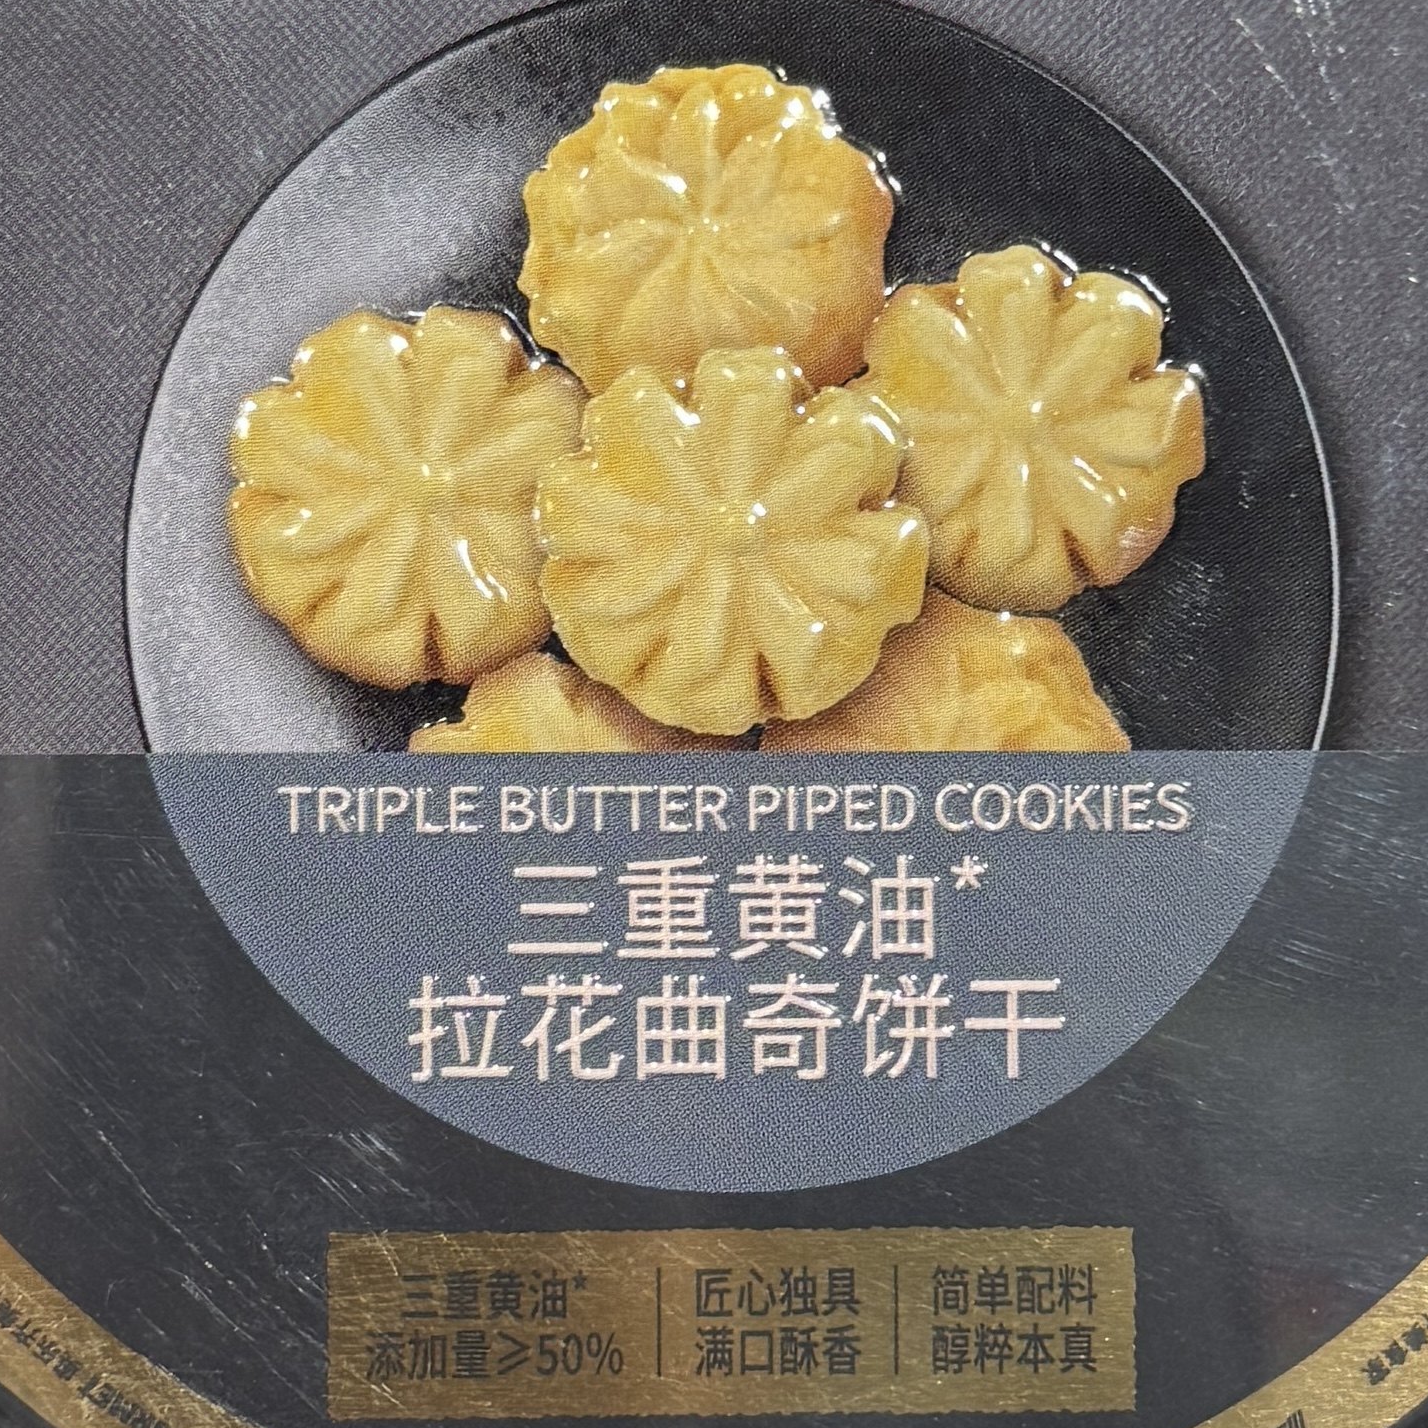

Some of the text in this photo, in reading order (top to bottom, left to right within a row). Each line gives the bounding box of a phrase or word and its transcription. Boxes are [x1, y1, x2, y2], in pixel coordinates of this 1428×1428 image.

[277, 782, 1192, 834] TRIPLE BUTTER PIPED COOKIES
[408, 973, 1066, 1083] 拉花曲奇饼干
[695, 1266, 862, 1318] 匠心独具
[931, 1263, 1097, 1316] 简单配料
[695, 1324, 862, 1377] 满口酥香
[931, 1321, 1097, 1376] 醇粹本真
